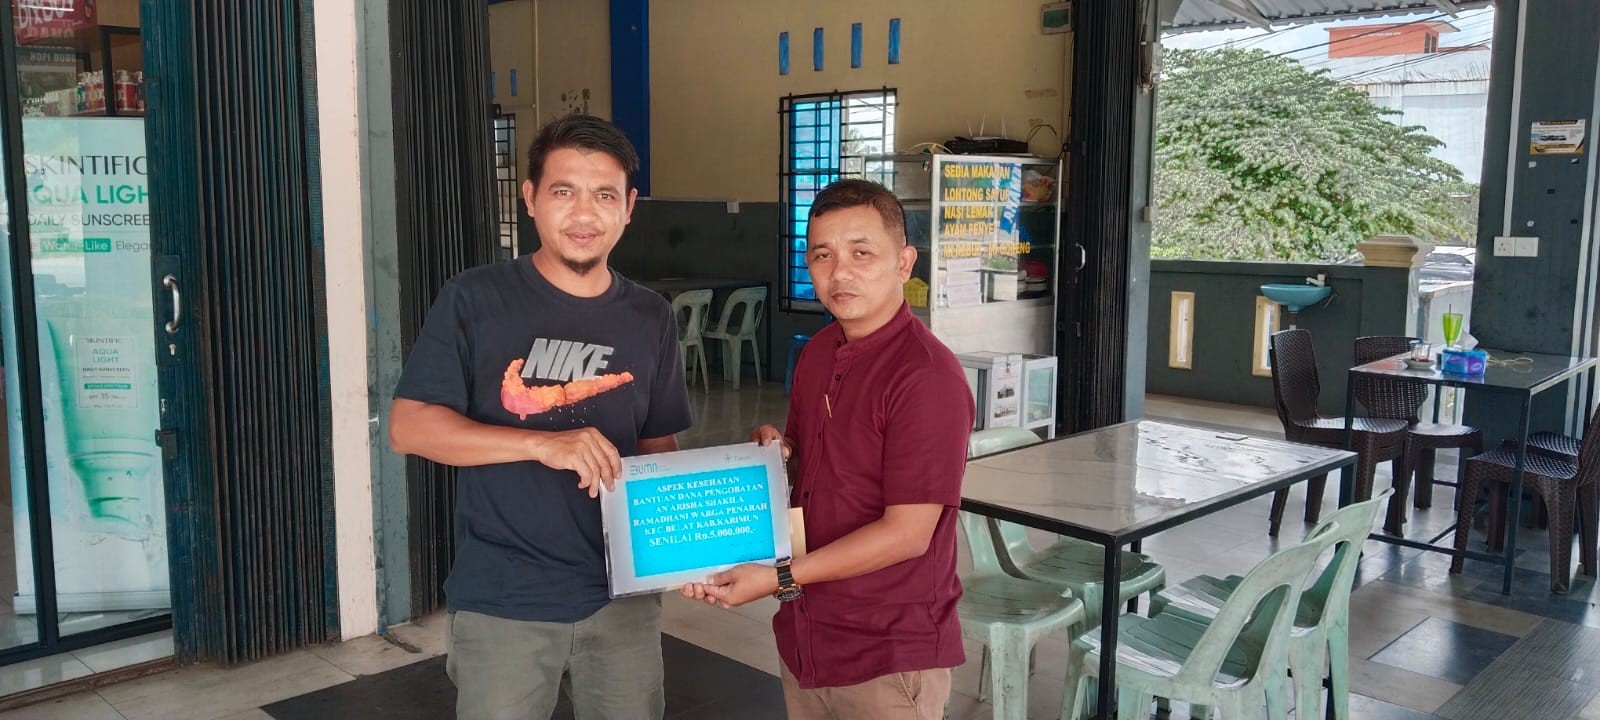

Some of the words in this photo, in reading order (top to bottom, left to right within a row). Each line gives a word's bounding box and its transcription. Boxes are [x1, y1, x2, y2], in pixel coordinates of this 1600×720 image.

[24, 155, 148, 176] SKINTIFIC
[944, 164, 969, 178] SEDIA
[971, 165, 1010, 179] MAKANAN
[28, 185, 88, 205] QUA
[96, 185, 149, 204] LIGH
[944, 187, 984, 202] LONTONG
[71, 213, 150, 226] SUNSCREE
[944, 205, 964, 219] NASI
[966, 205, 994, 219] LEMAK
[944, 223, 967, 236] AYAM
[520, 337, 614, 383] NIKE
[656, 482, 684, 493] ASPEK
[686, 476, 740, 490] KESEHATAN
[633, 493, 676, 507] BANTUAN
[678, 489, 703, 501] DANA
[704, 482, 764, 497] PENGOBATAN
[655, 504, 668, 514] AN
[670, 500, 704, 513] ARISHA
[704, 495, 745, 508] SHAKILA
[633, 512, 689, 528] RAMADHANI
[690, 508, 725, 520] WARGA
[726, 502, 768, 515] PENARAH
[648, 533, 693, 548] SENILAI
